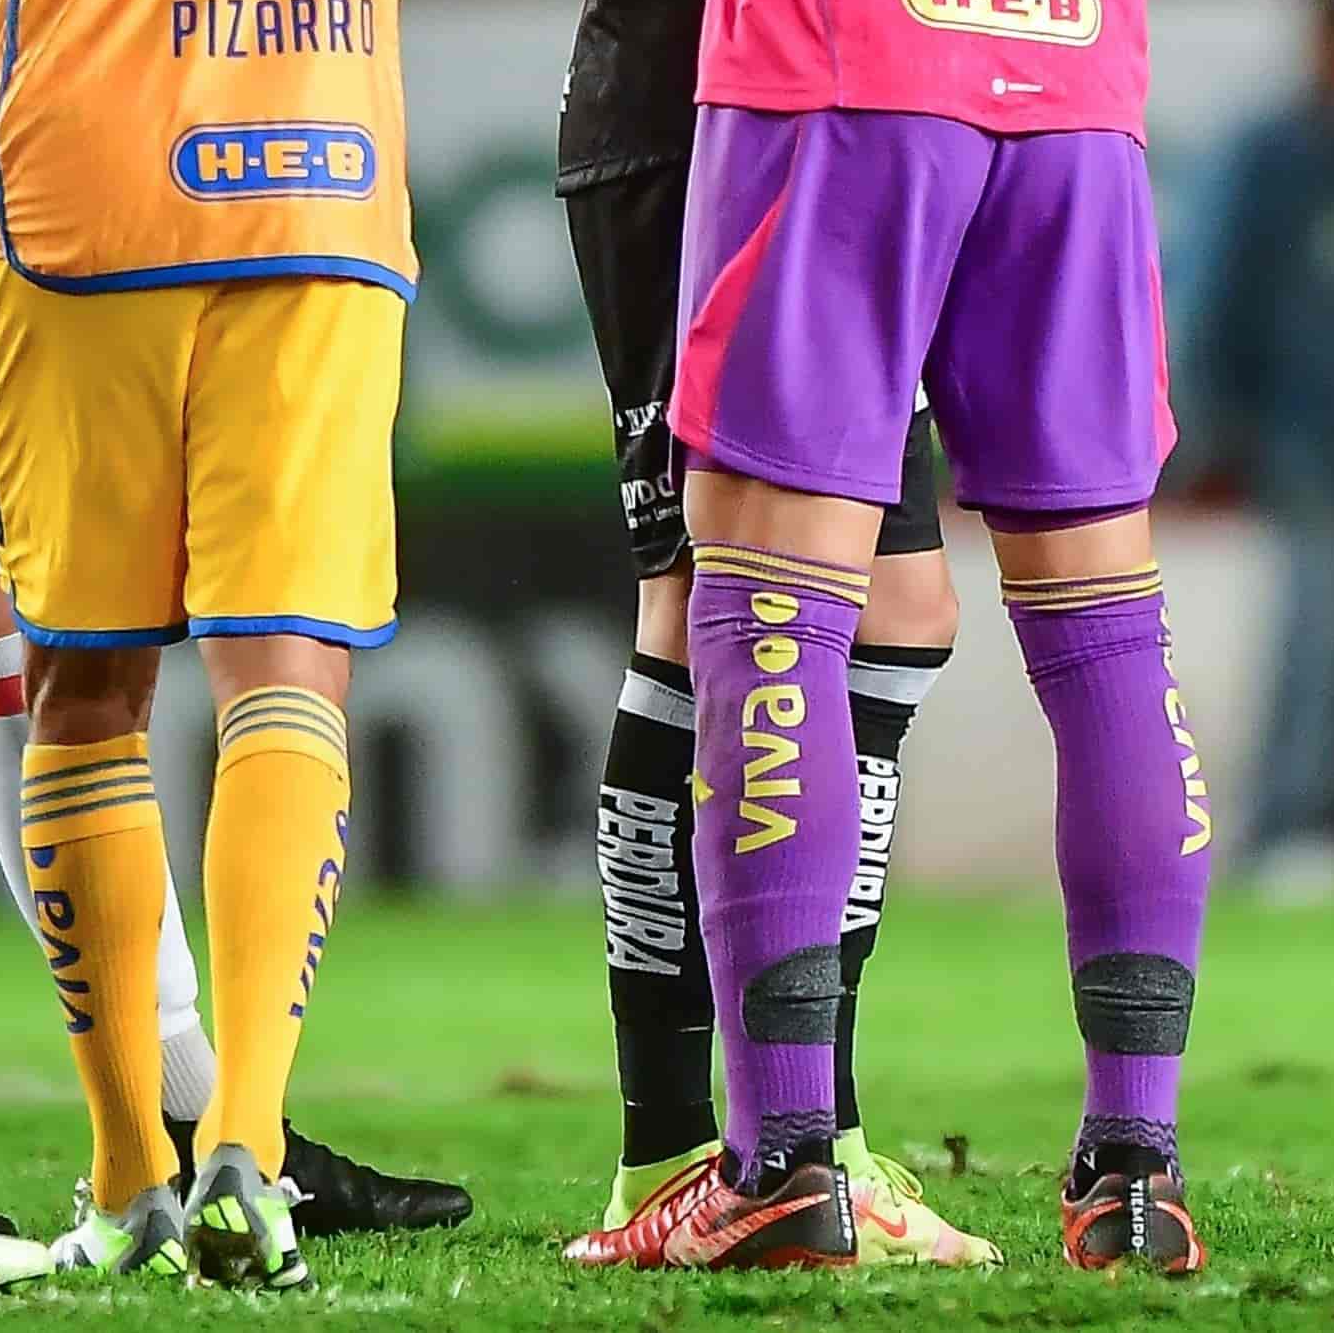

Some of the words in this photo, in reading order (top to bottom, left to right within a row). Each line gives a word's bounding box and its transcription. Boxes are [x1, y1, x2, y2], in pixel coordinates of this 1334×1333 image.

[597, 783, 687, 976] PERDURA
[841, 754, 901, 933] PERDURA
[1130, 1179, 1145, 1248] TIEMPO
